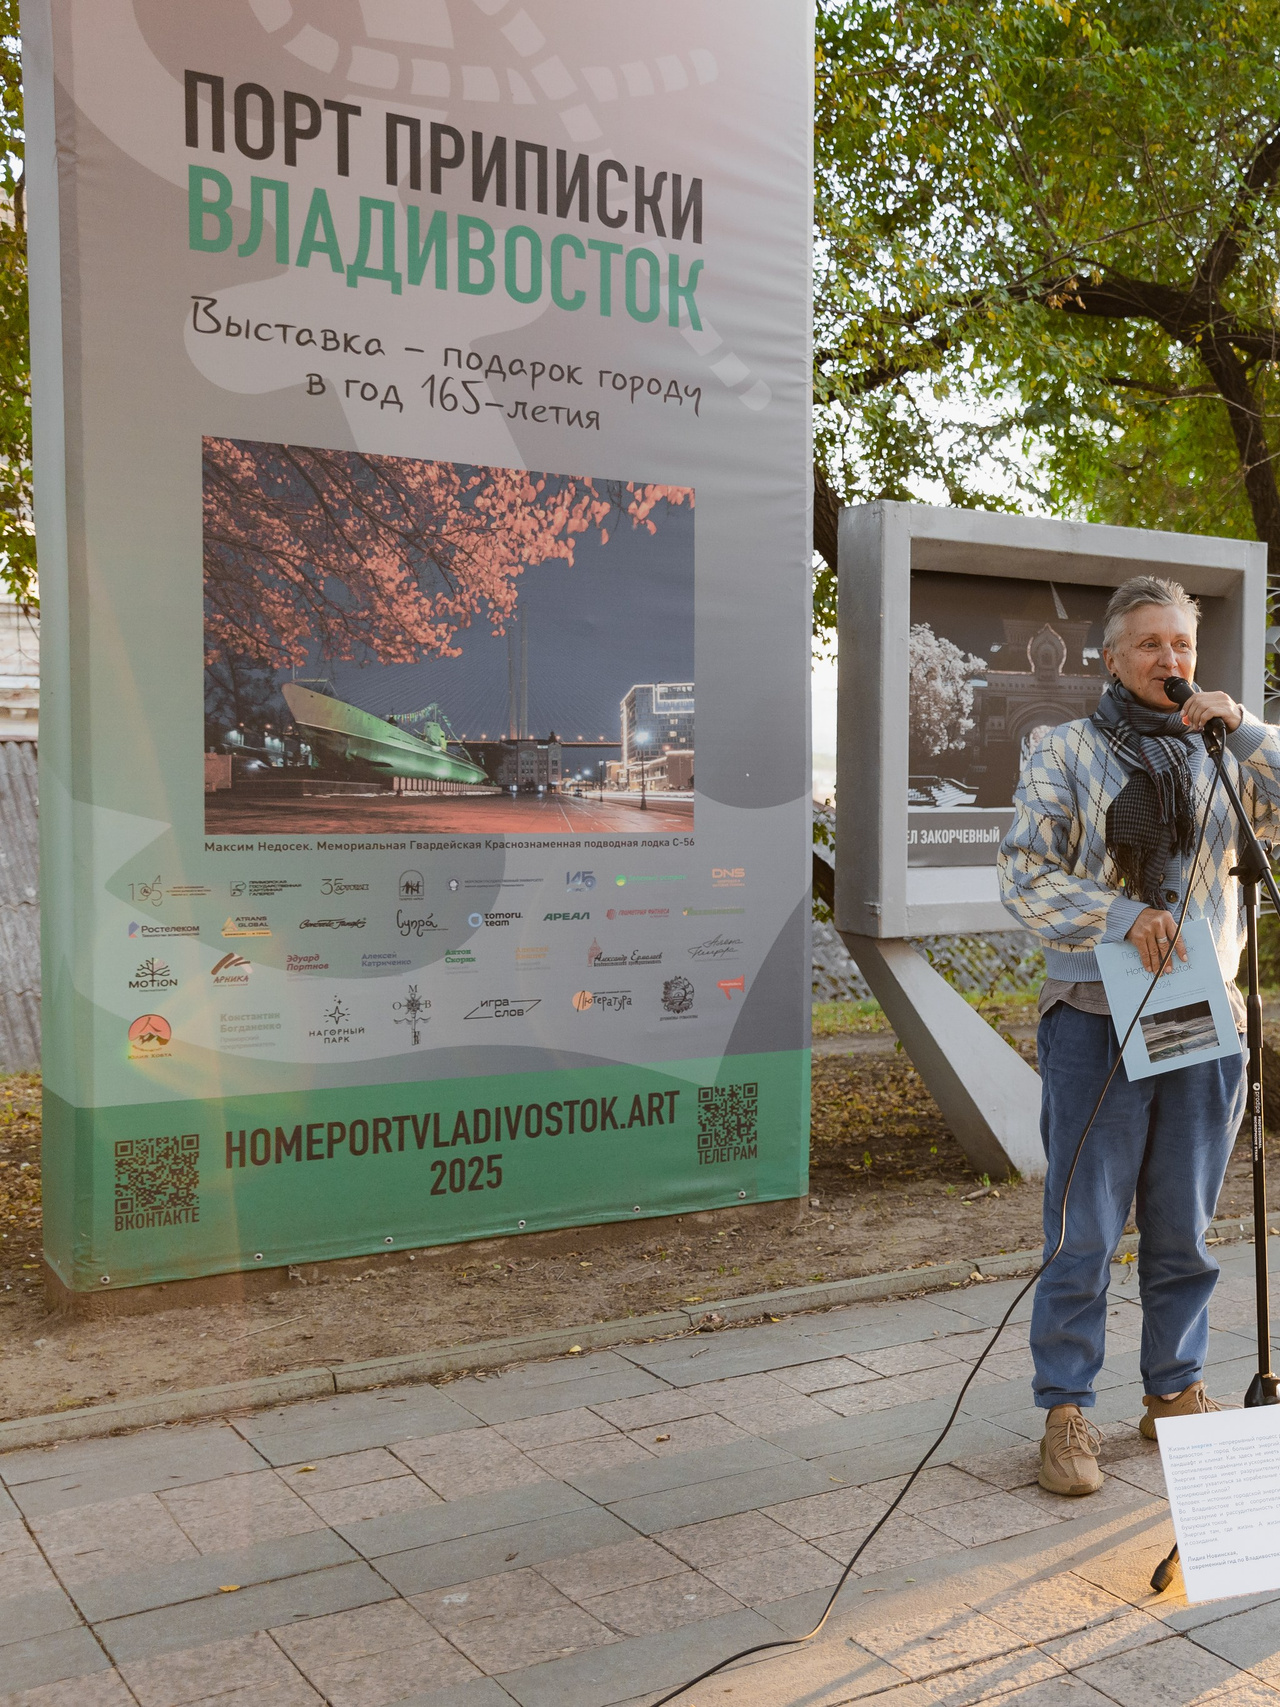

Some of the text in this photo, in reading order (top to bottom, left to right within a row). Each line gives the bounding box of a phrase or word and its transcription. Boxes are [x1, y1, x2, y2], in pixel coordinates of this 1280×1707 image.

[184, 69, 703, 245] ПОРТ ПРИПИСКИ
[188, 164, 704, 332] ВЛАДИВОСТОК
[190, 295, 386, 356] Выставка
[443, 345, 584, 391] подарок
[598, 369, 703, 418] городу
[306, 373, 601, 432] в год 165-летия
[920, 826, 1000, 844] ЗАКОРЧЕВНЫЙ
[204, 837, 695, 853] Максим Недосек. Мемориальная Гвардейская Краснознаменная подводная лодка С-56
[712, 868, 745, 879] DNS
[542, 912, 590, 922] АРЕАЛ
[484, 919, 510, 927] team
[141, 924, 200, 934] Ростелеком
[286, 953, 320, 964] Эдуард
[361, 951, 398, 960] Алексей
[445, 956, 476, 964] Скорик
[286, 963, 330, 972] Портнов
[212, 974, 249, 984] АРНИКА
[480, 999, 510, 1008] игра
[220, 1012, 280, 1022] Константин
[494, 1008, 524, 1018] слов
[308, 1026, 366, 1037] НАГОРНЫЙ
[324, 1036, 350, 1044] ПАРК
[225, 1090, 681, 1170] HOMEPORTVLADIVOSTOK.ART
[698, 1143, 758, 1166] ТЕЛЕГРАМ
[430, 1153, 504, 1197] 2025
[114, 1205, 200, 1232] ВКОНТАКТЕ
